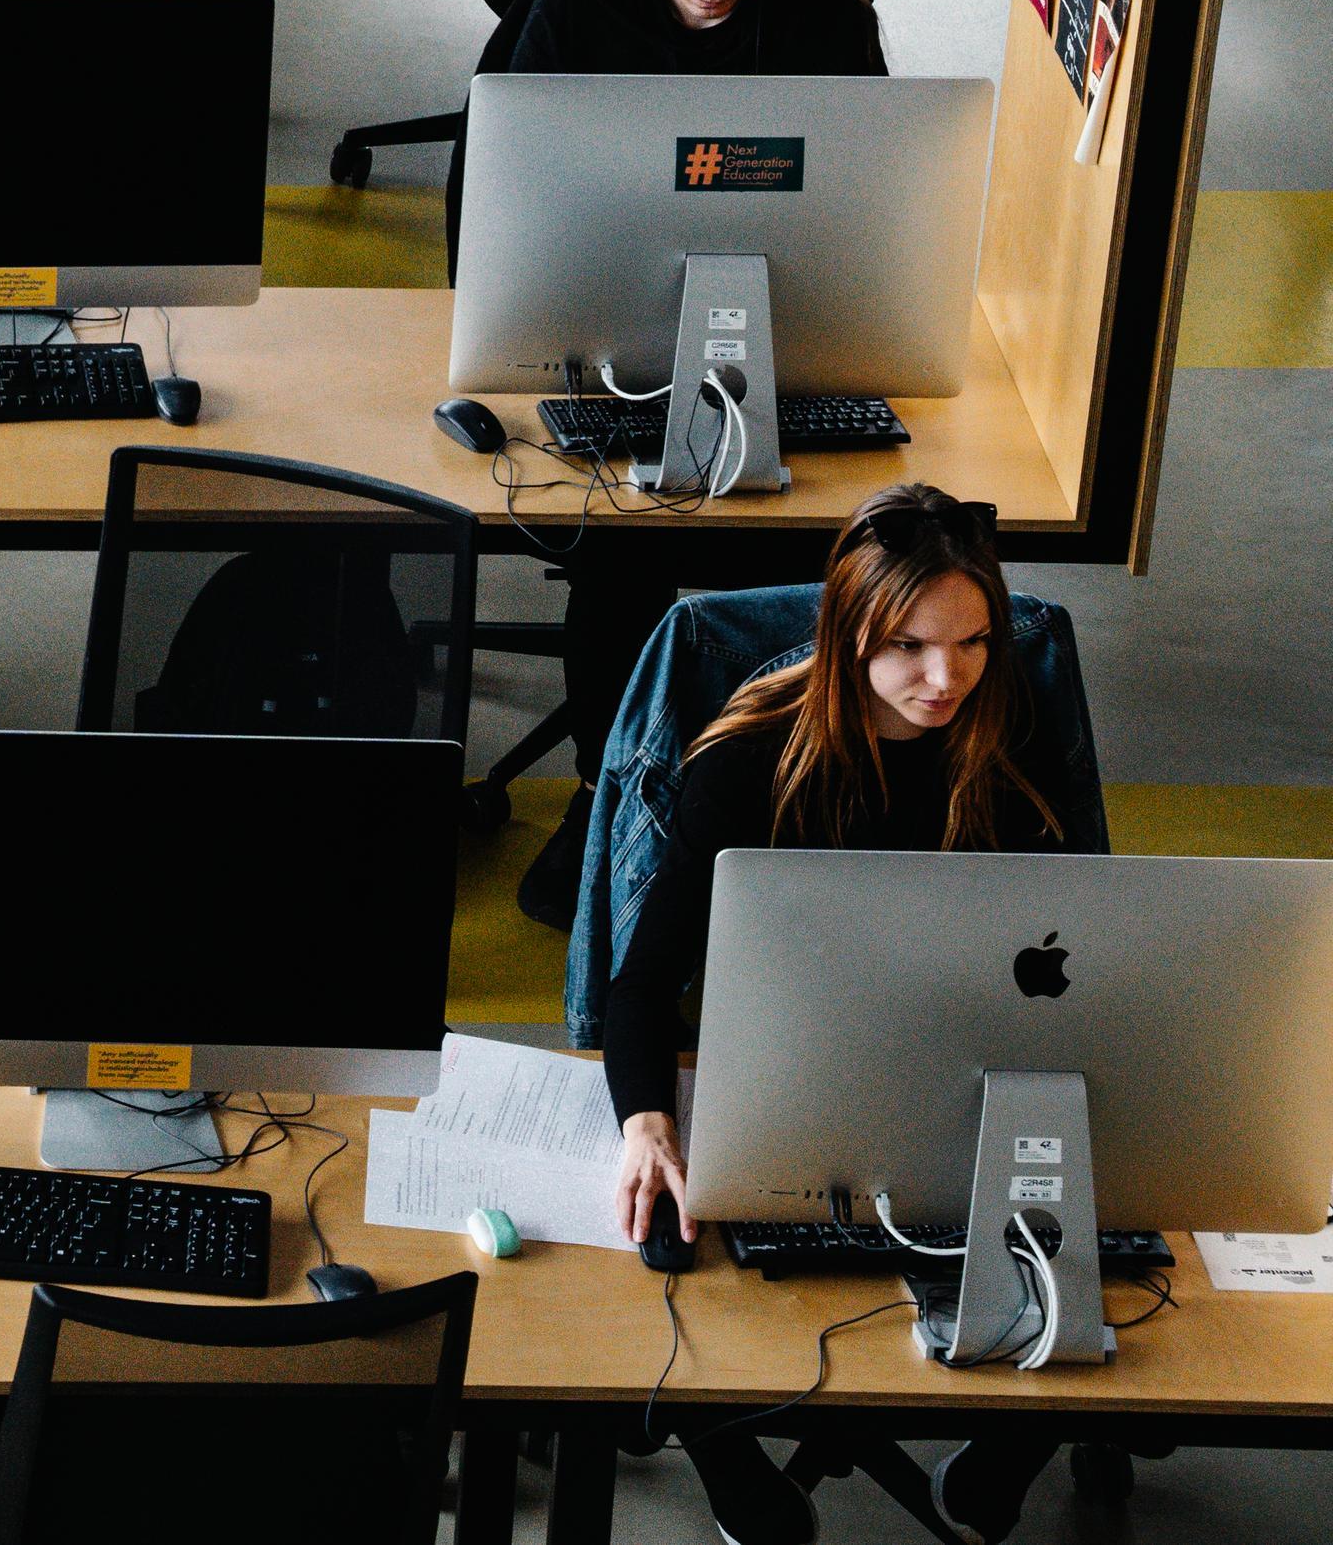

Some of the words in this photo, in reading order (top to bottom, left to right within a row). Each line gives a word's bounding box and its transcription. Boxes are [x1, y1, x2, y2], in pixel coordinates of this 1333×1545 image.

[726, 144, 757, 155] Next
[725, 156, 793, 168] Generation
[723, 168, 783, 180] Education
[232, 1196, 261, 1205] logitech
[1259, 1266, 1313, 1276] jobcenter
